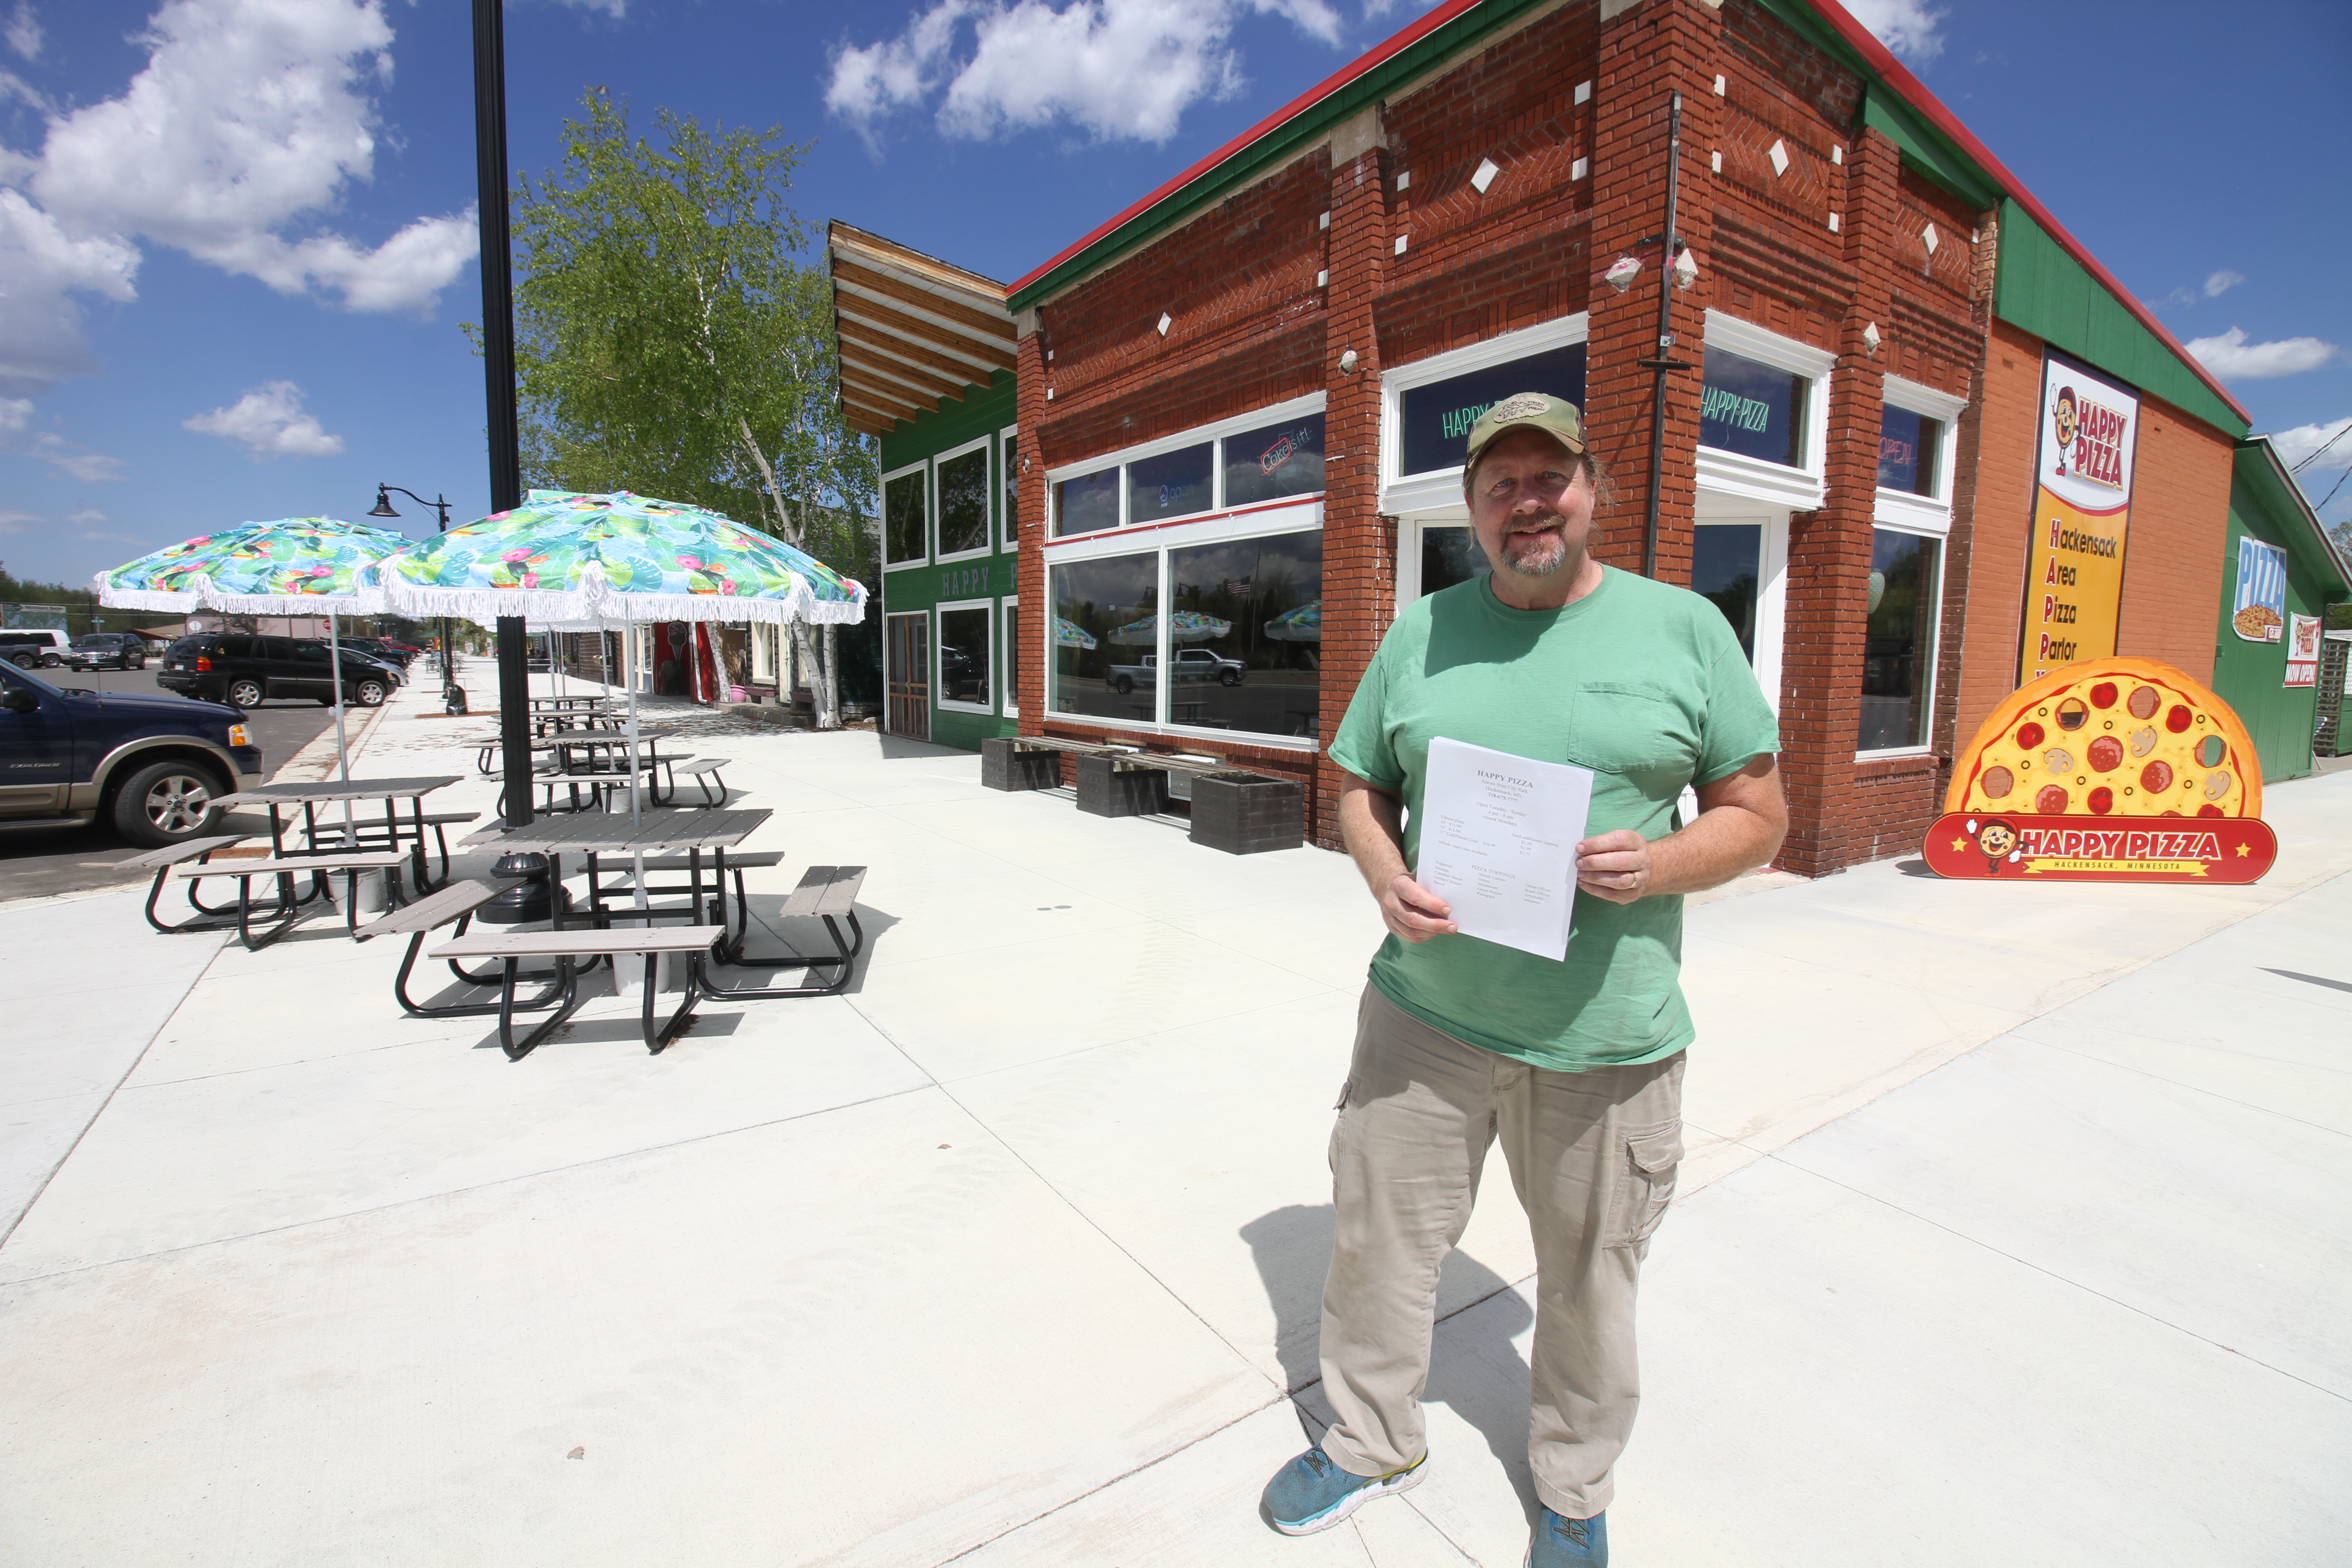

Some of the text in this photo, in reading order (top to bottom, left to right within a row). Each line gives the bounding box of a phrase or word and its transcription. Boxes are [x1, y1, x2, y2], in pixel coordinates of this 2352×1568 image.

[1701, 385, 1769, 433] HAPPY PIZZA
[2078, 396, 2128, 451] HAPPY
[1263, 445, 1289, 470] Coke
[1879, 437, 1911, 465] OPEN
[2073, 435, 2123, 491] PIZZA
[2048, 518, 2117, 559] Hackensack
[942, 566, 989, 596] HAPPY
[2044, 556, 2077, 586] Area
[2235, 540, 2287, 618] PIZZA
[2043, 594, 2077, 624] Pizza
[2038, 632, 2077, 662] Parlor
[2285, 664, 2317, 682] NOW OPEN!
[1477, 769, 1533, 788] HAPPY PIZZA
[1488, 793, 1518, 803] 218-675-7777
[1490, 804, 1506, 813] Tuesday
[1446, 832, 1468, 840] Cauliflower
[1498, 818, 1517, 826] Mondays
[2020, 829, 2222, 860] HAPPY PIZZA
[1436, 860, 1453, 868] Pepperoni
[1471, 864, 1515, 879] PIZZA TOPPINGS
[2055, 861, 2118, 870] HACKENSACK,
